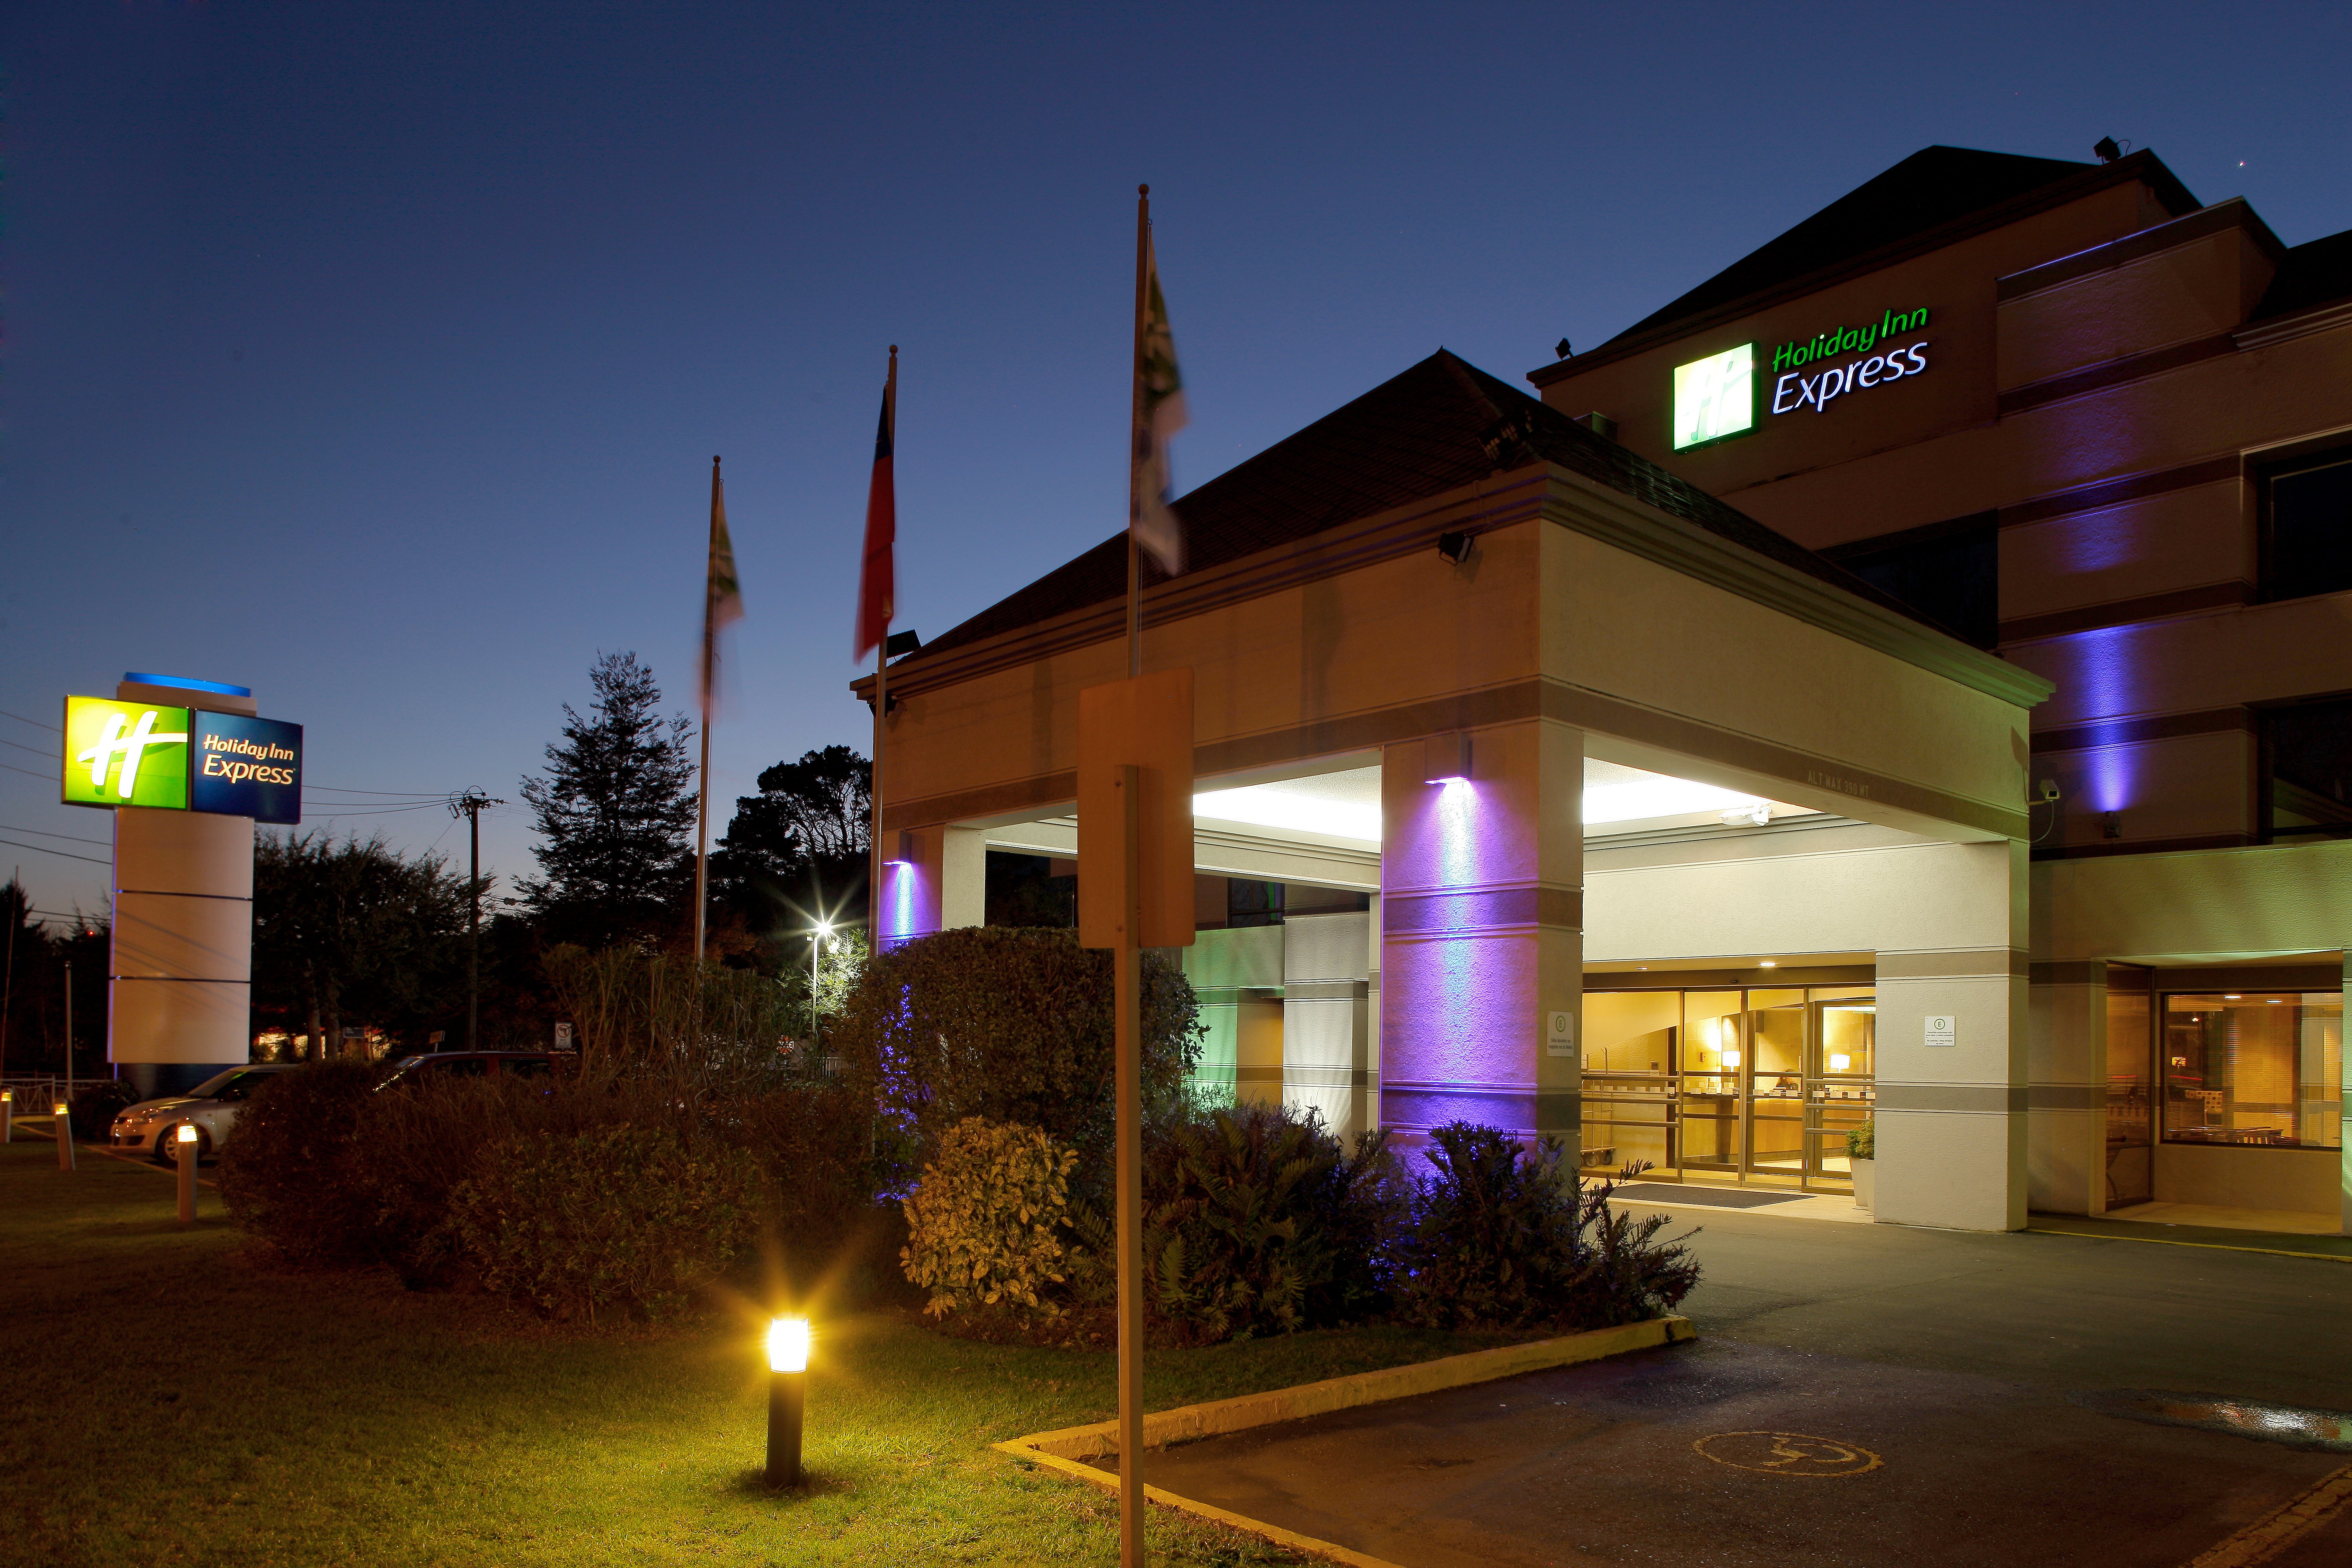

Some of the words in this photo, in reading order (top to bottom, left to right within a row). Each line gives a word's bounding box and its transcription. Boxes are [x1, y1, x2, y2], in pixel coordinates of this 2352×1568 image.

[1772, 323, 1877, 372] Holiday
[1882, 308, 1927, 338] Inn
[1773, 342, 1928, 414] Express
[203, 734, 268, 760] Holiday
[269, 743, 294, 760] Inn
[203, 753, 294, 784] Express
[1844, 780, 1857, 795] 390
